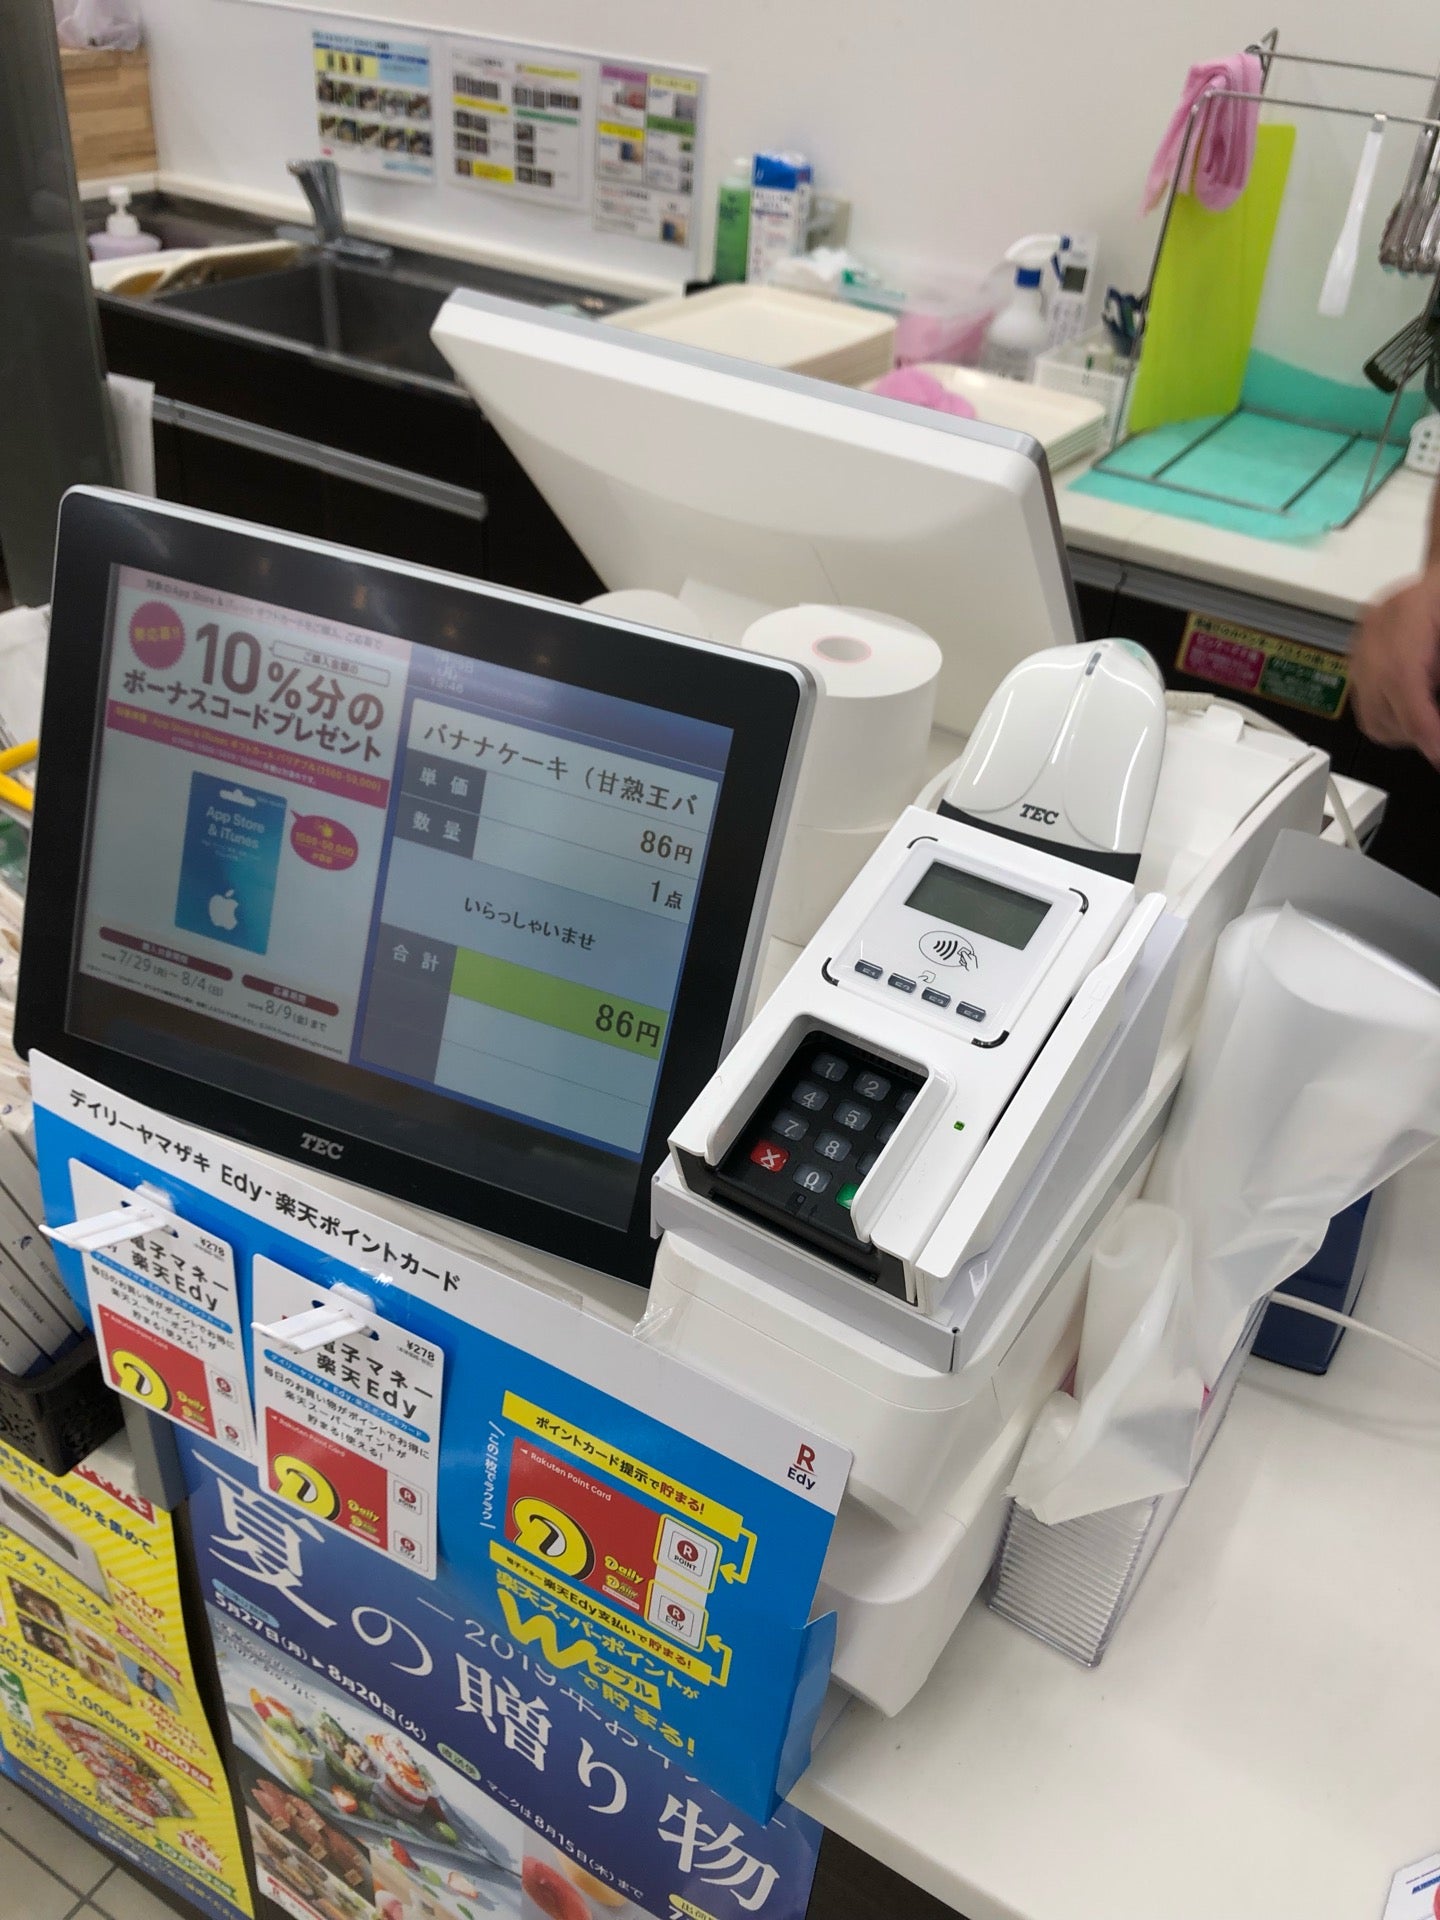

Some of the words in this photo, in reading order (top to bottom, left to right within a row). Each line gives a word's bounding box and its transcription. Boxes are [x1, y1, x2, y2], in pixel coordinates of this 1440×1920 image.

[196, 622, 384, 731] 10%分の
[123, 669, 382, 762] ボーナスコードプレゼント
[205, 805, 231, 827] App
[233, 811, 265, 834] Store
[411, 810, 462, 843] 数量
[1019, 803, 1060, 827] TEC
[640, 829, 694, 866] 86円
[650, 879, 683, 911] 1点
[463, 896, 597, 951] いらっしゃいませ
[392, 942, 441, 973] 合計
[595, 1003, 661, 1049] 86円
[824, 1061, 836, 1079] 1
[803, 1090, 818, 1108] 4
[866, 1079, 879, 1096] 2
[69, 1087, 210, 1174] デイリーヤマザキ
[785, 1120, 798, 1136] 7
[846, 1108, 860, 1126] 5
[300, 1132, 344, 1160] TEC
[824, 1138, 841, 1157] 8
[805, 1169, 820, 1188] 0
[131, 1249, 218, 1313] 楽天Edy
[406, 1339, 436, 1363] ¥278
[316, 1351, 418, 1420] 楽天Edy
[263, 1364, 431, 1460] 毎日のお買い物がポイントでお得に
[284, 1389, 408, 1460] 楽天スーパーポイントが
[535, 1416, 706, 1516] ポイントカード提示で貯まる!
[795, 1443, 817, 1473] R
[530, 1451, 567, 1480] Rakuten
[567, 1470, 590, 1492] Point
[590, 1480, 613, 1502] Card
[786, 1466, 817, 1492] Edy
[603, 1555, 645, 1585] Daily
[673, 1553, 698, 1573] POINT
[496, 1568, 700, 1700] 楽天スーパーポイントが
[664, 1613, 685, 1632] Edy
[214, 1591, 309, 1662] 5月27日(月)
[327, 1663, 428, 1743] 8月20日(火)
[593, 1661, 653, 1699] ダブル
[578, 1670, 696, 1758] で貯まる!
